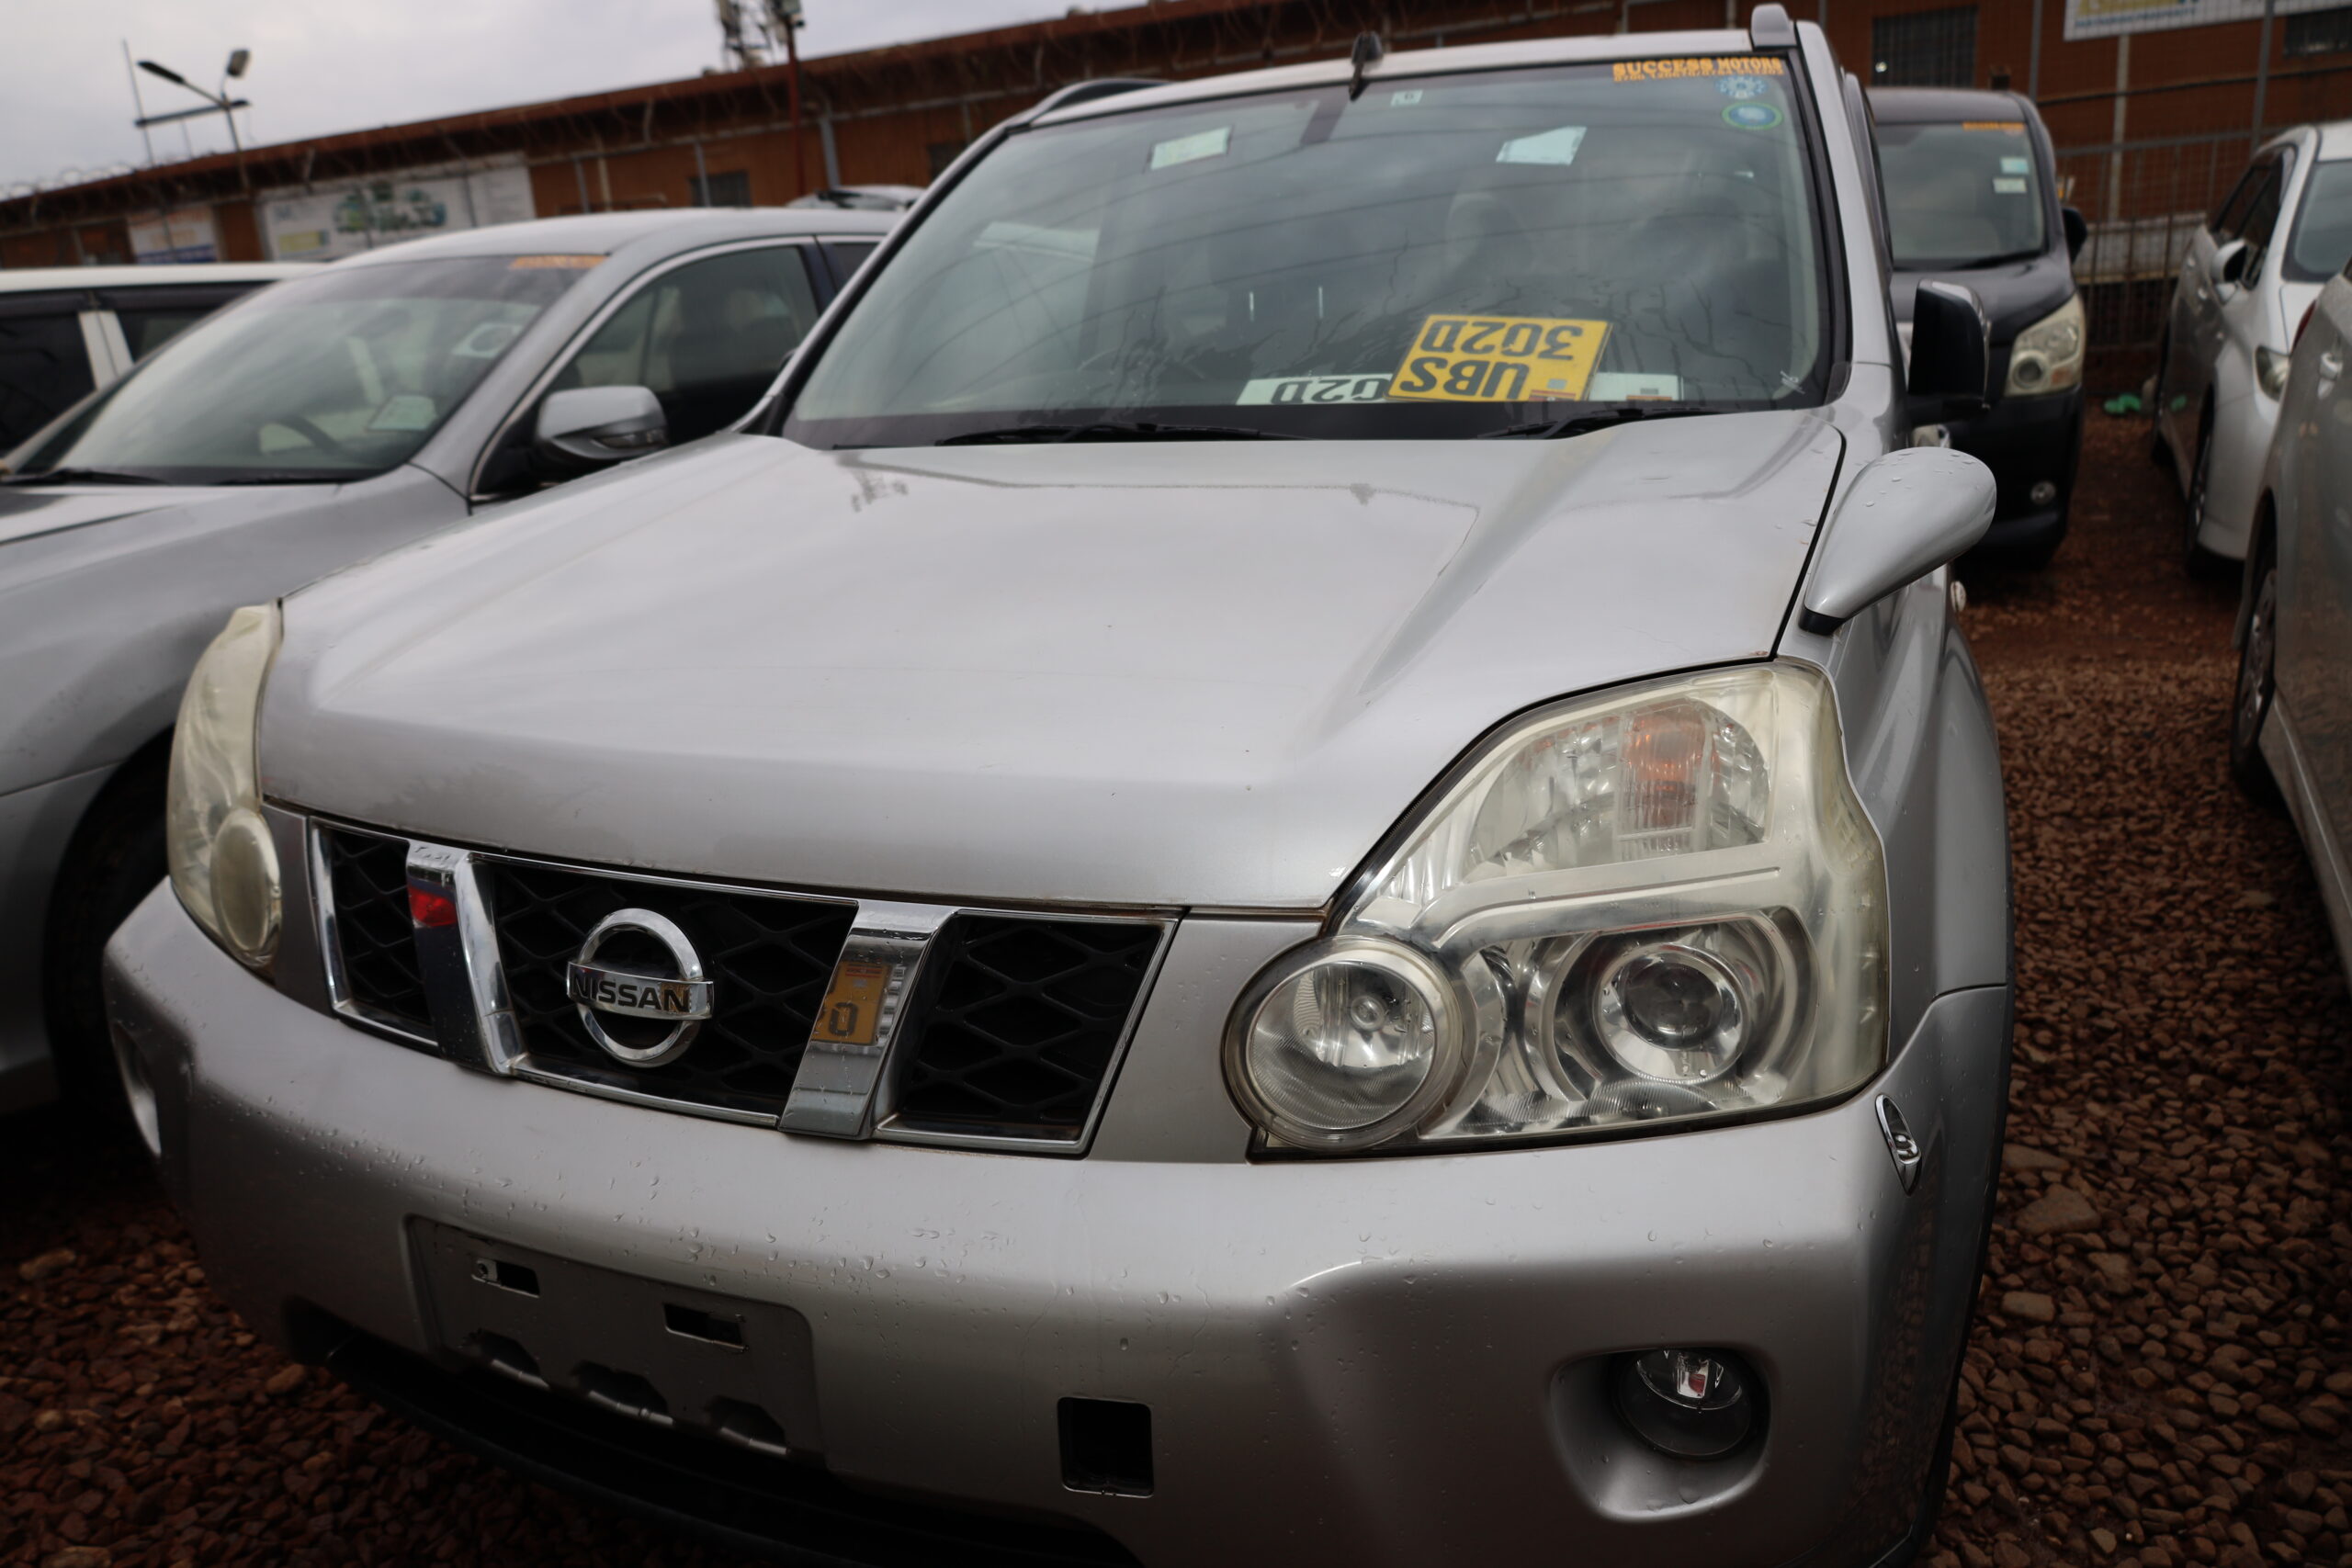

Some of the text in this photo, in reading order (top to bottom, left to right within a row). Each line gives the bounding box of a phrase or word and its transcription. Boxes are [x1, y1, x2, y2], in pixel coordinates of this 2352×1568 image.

[1612, 58, 1713, 77] SUCCESS
[1716, 56, 1783, 74] MOTORS
[1419, 320, 1584, 361] 302D
[1399, 357, 1530, 400] UBS
[571, 975, 691, 1014] NISSAN
